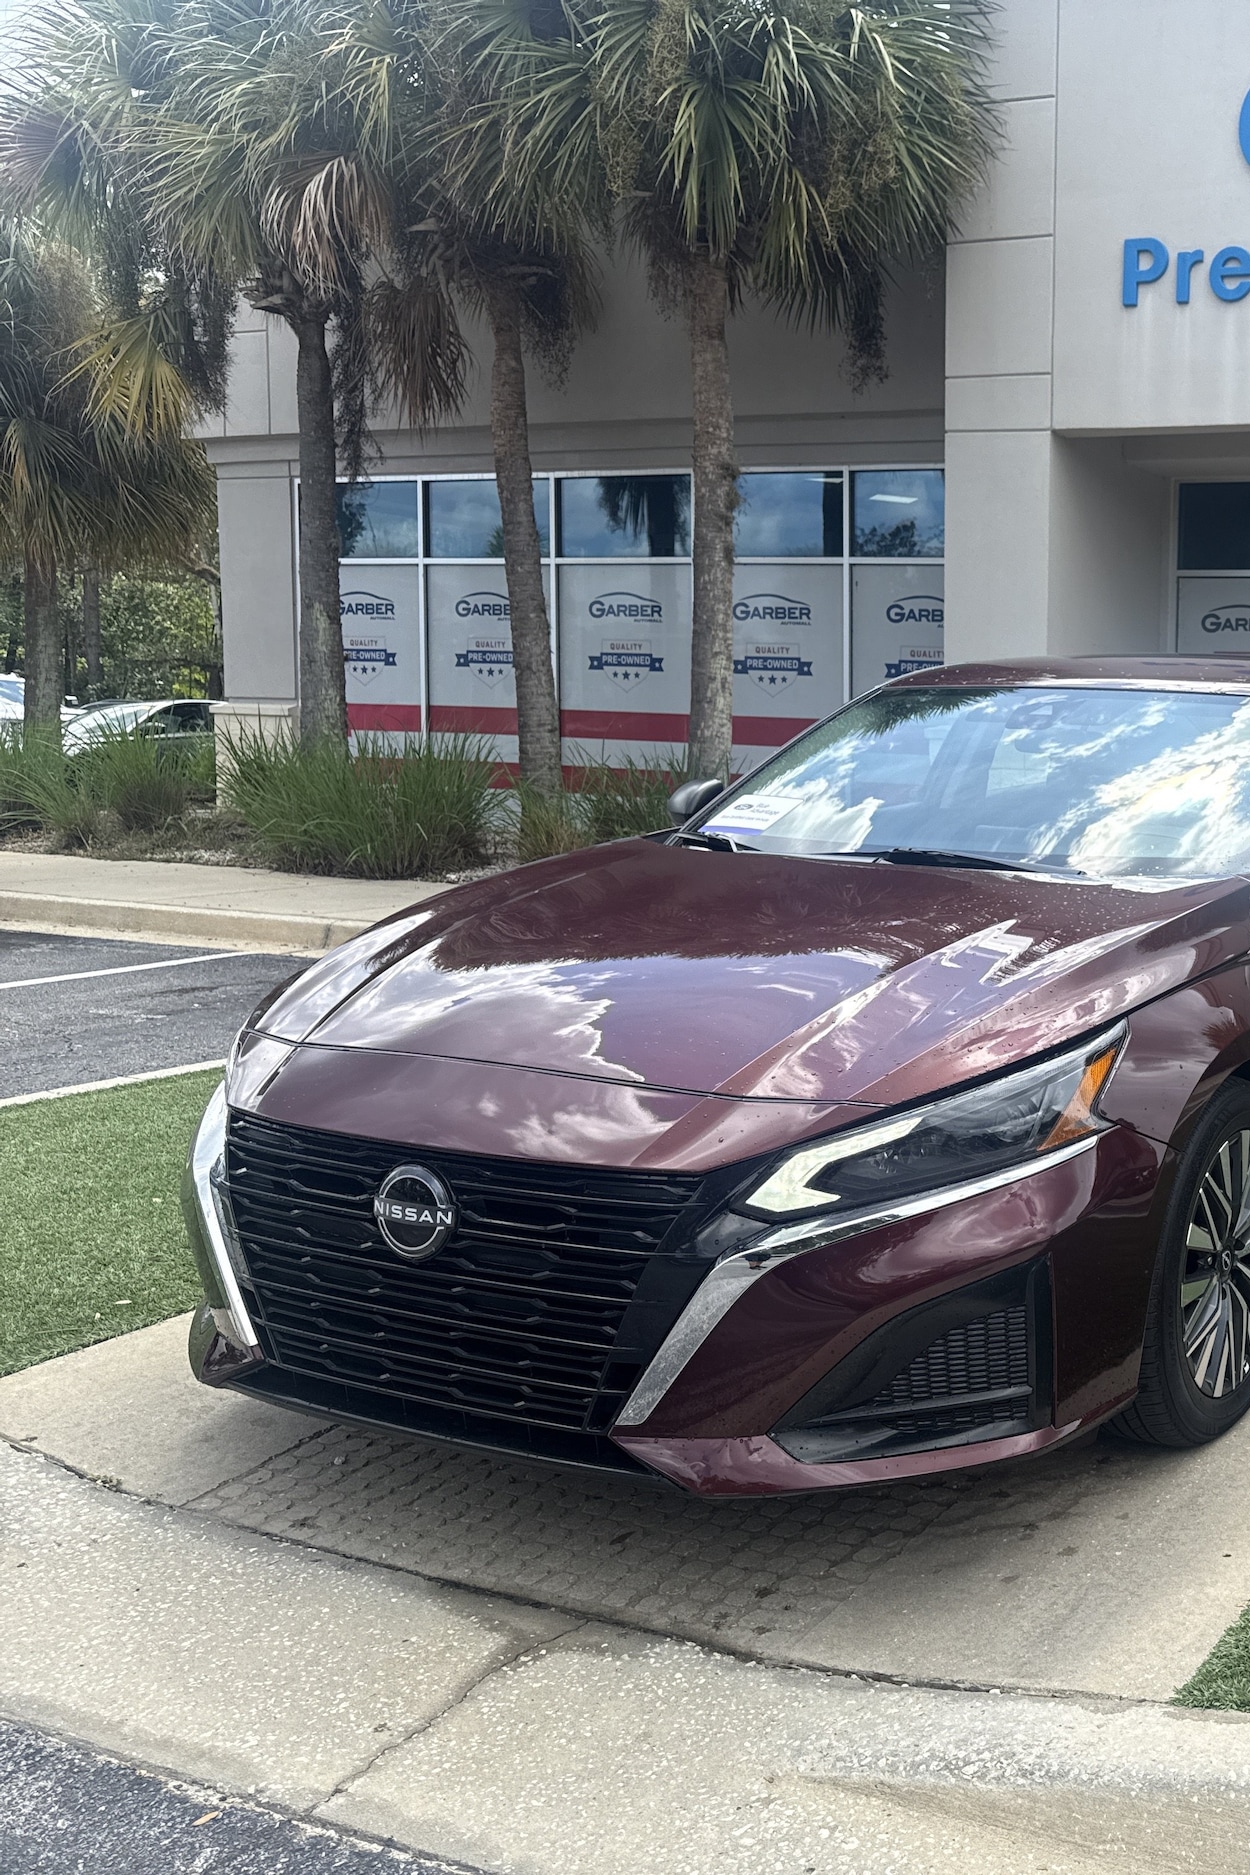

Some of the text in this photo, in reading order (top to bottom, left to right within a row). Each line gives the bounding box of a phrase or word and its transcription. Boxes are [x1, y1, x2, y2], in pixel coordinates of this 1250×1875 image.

[455, 600, 510, 617] GARBE
[588, 600, 662, 618] GARBER
[732, 602, 811, 621] GARBER
[886, 603, 944, 623] GARB
[350, 639, 378, 647] QUALITY
[755, 646, 790, 654] QUALITY
[468, 652, 513, 662] PRE-OWNED
[602, 655, 651, 665] PRE-OWNED
[746, 659, 799, 669] PRE-OWNED
[374, 1199, 452, 1225] NISSAN
